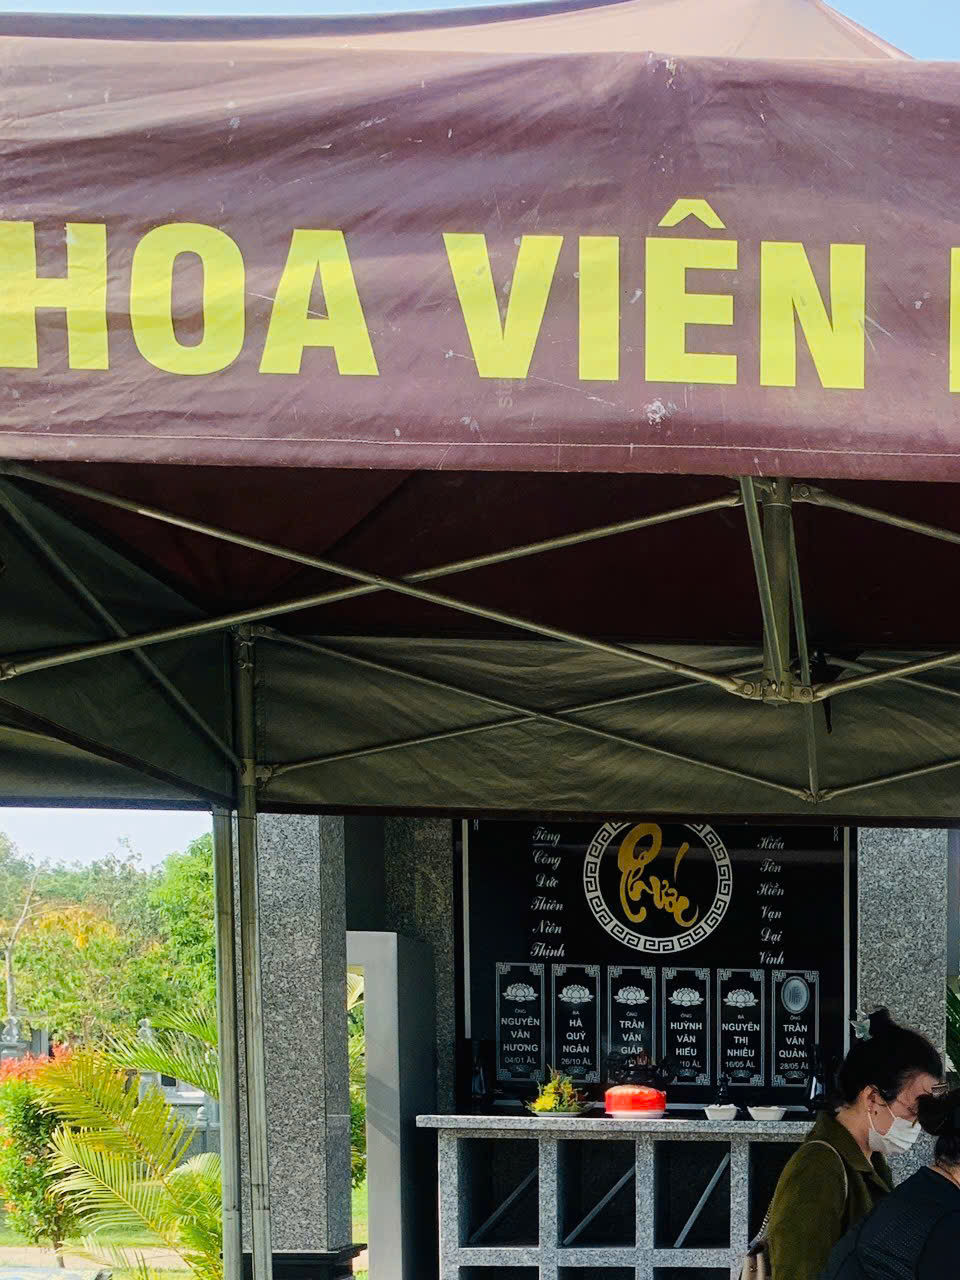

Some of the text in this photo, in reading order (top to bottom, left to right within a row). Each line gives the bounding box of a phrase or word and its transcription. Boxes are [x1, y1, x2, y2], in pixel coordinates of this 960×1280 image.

[0, 221, 379, 375] HOA
[443, 198, 865, 389] VIÊN
[532, 849, 562, 870] Công
[760, 858, 782, 872] Tôn
[530, 896, 563, 911] Thiên
[761, 905, 782, 921] Vạn
[532, 919, 562, 934] Niên
[760, 927, 783, 944] Đại
[530, 942, 565, 959] Thịnh
[759, 951, 785, 965] Vinh
[619, 1018, 645, 1029] TRẦN
[670, 1021, 703, 1030] HUỲNH
[722, 1021, 760, 1031] NGUYỄN
[783, 1022, 808, 1032] TRẦN
[510, 1029, 531, 1039] VĂN
[622, 1032, 642, 1042] VĂN
[676, 1034, 696, 1043] VĂN
[733, 1036, 749, 1046] THỊ
[785, 1036, 805, 1045] VĂN
[503, 1043, 539, 1052] HƯƠNG
[620, 1045, 643, 1054] GIÁP
[675, 1046, 697, 1056] HIẾU
[779, 1047, 807, 1058] QUẢN
